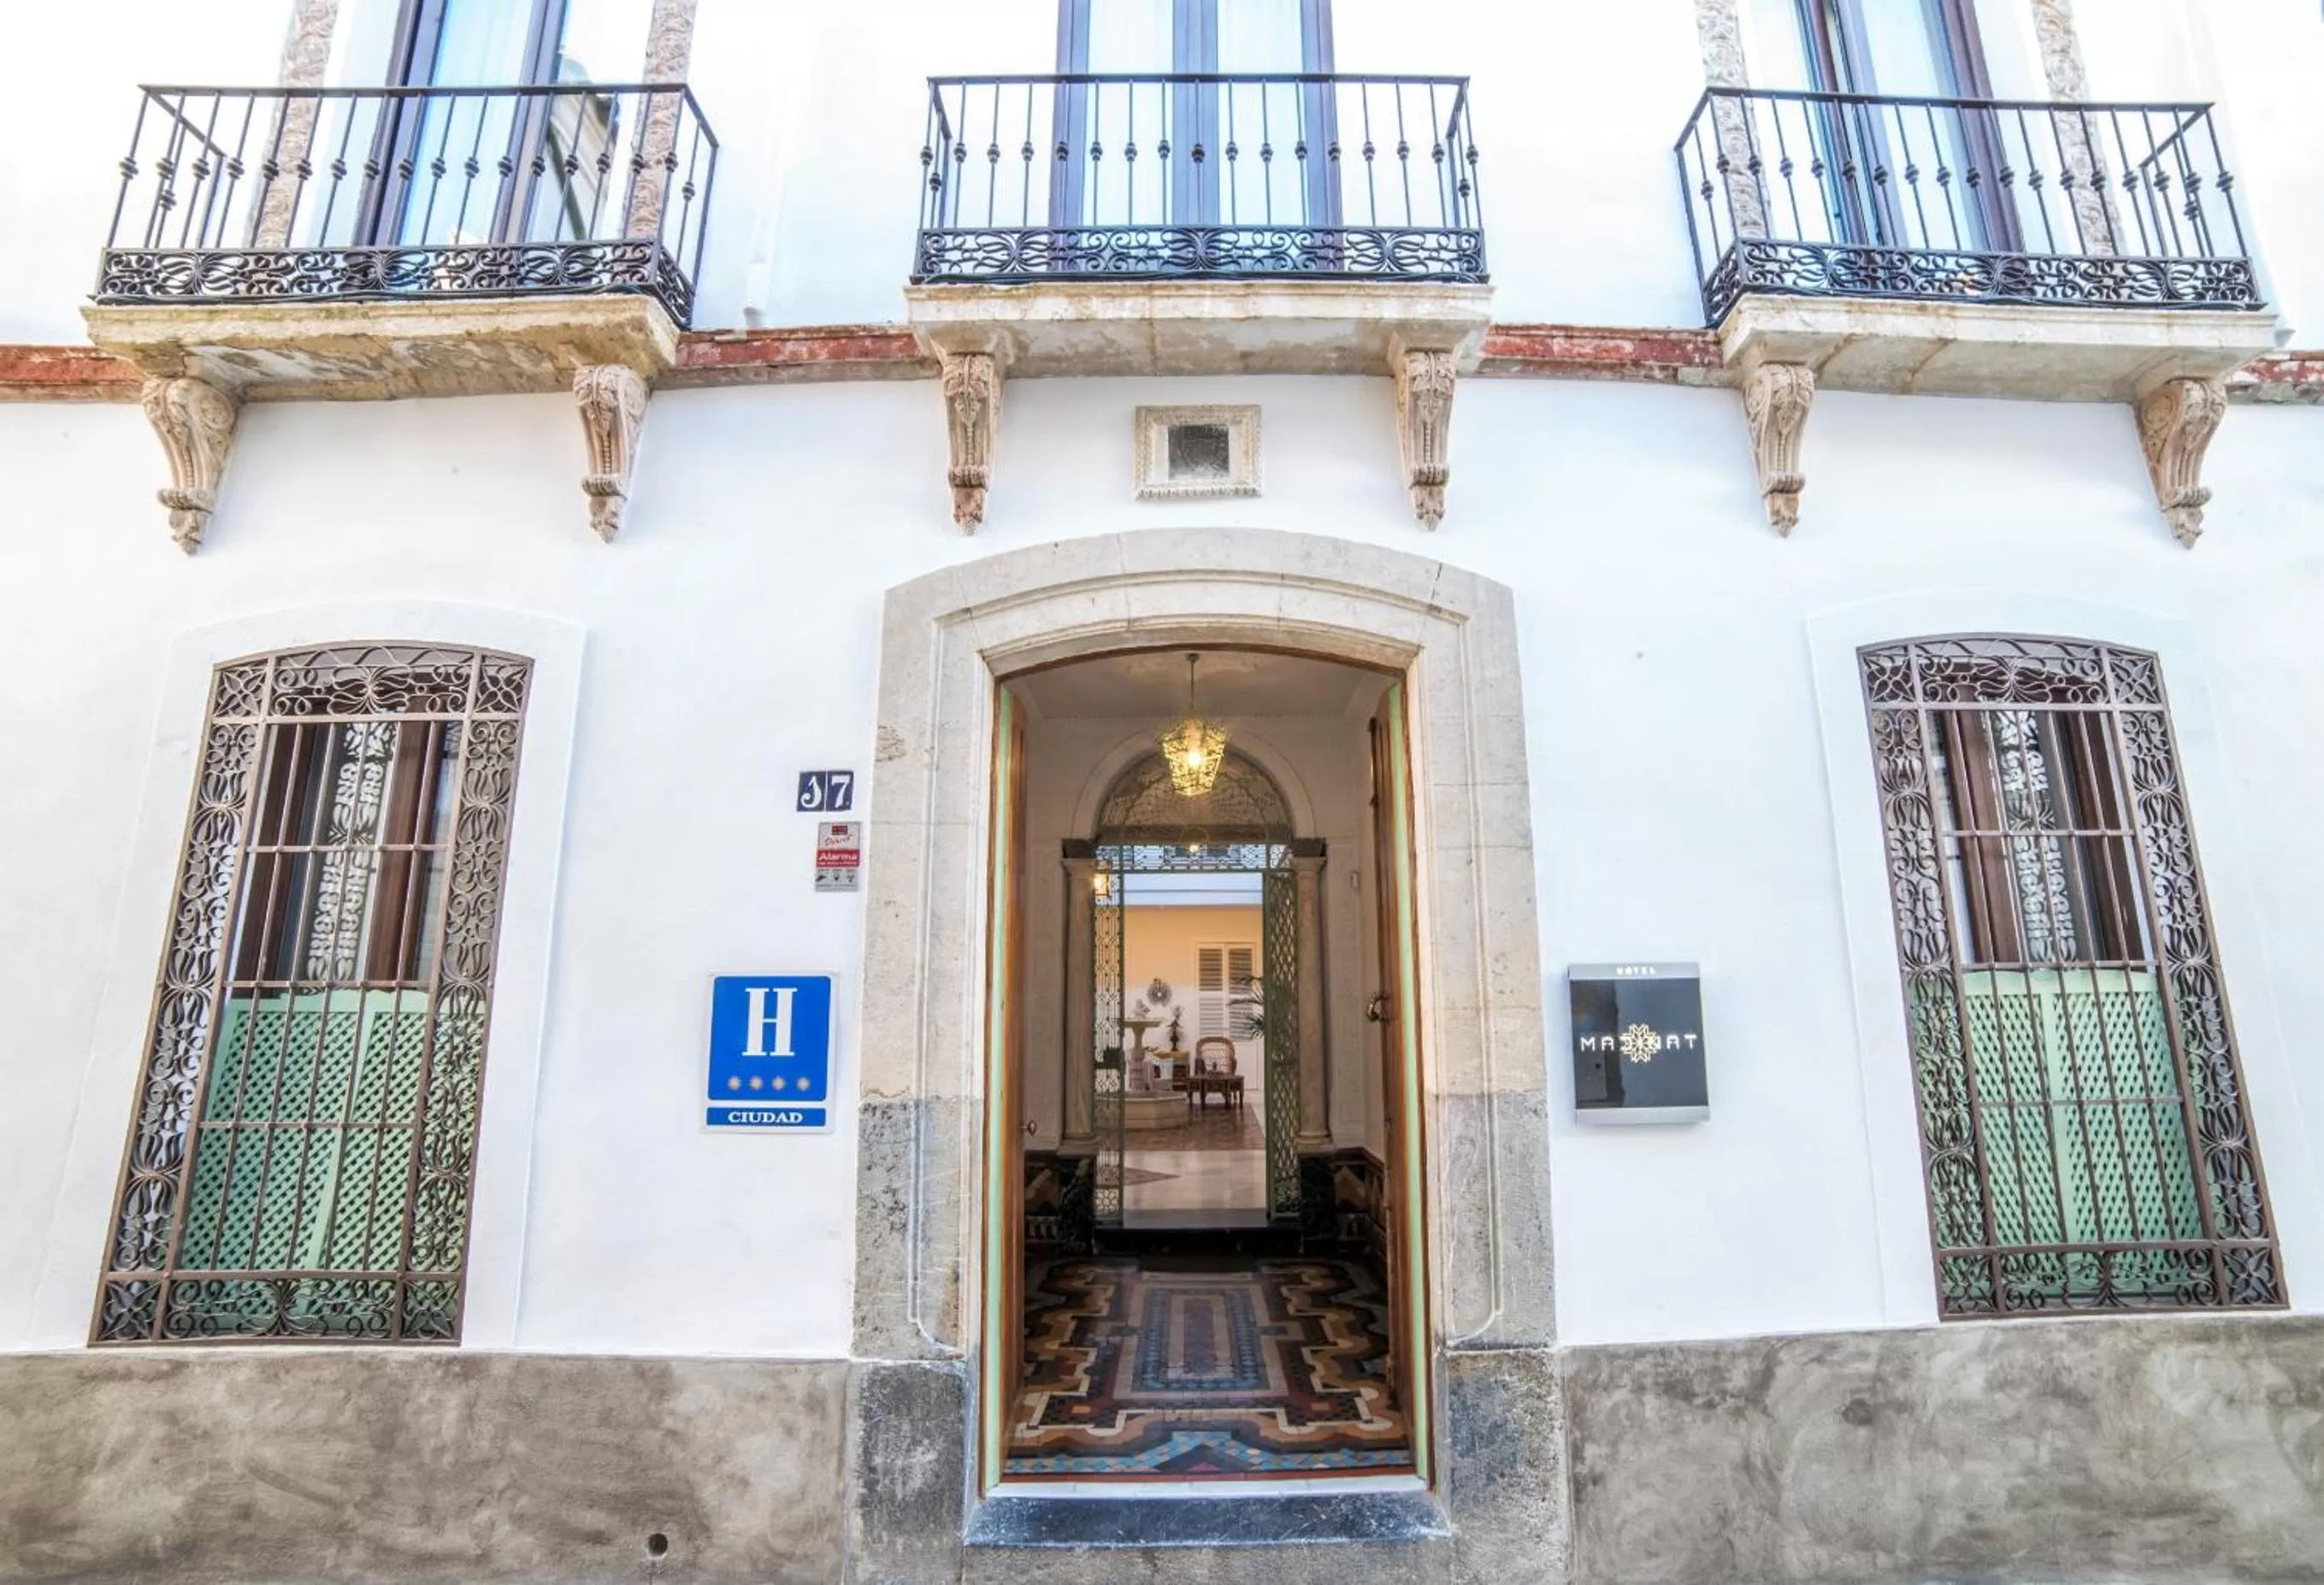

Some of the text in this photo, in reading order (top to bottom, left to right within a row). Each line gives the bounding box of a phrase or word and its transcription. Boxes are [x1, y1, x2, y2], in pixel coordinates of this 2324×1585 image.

[818, 852, 858, 862] Alarma
[1616, 966, 1656, 975] HOTEL
[741, 987, 799, 1057] H
[728, 1111, 804, 1124] CIUDAD
